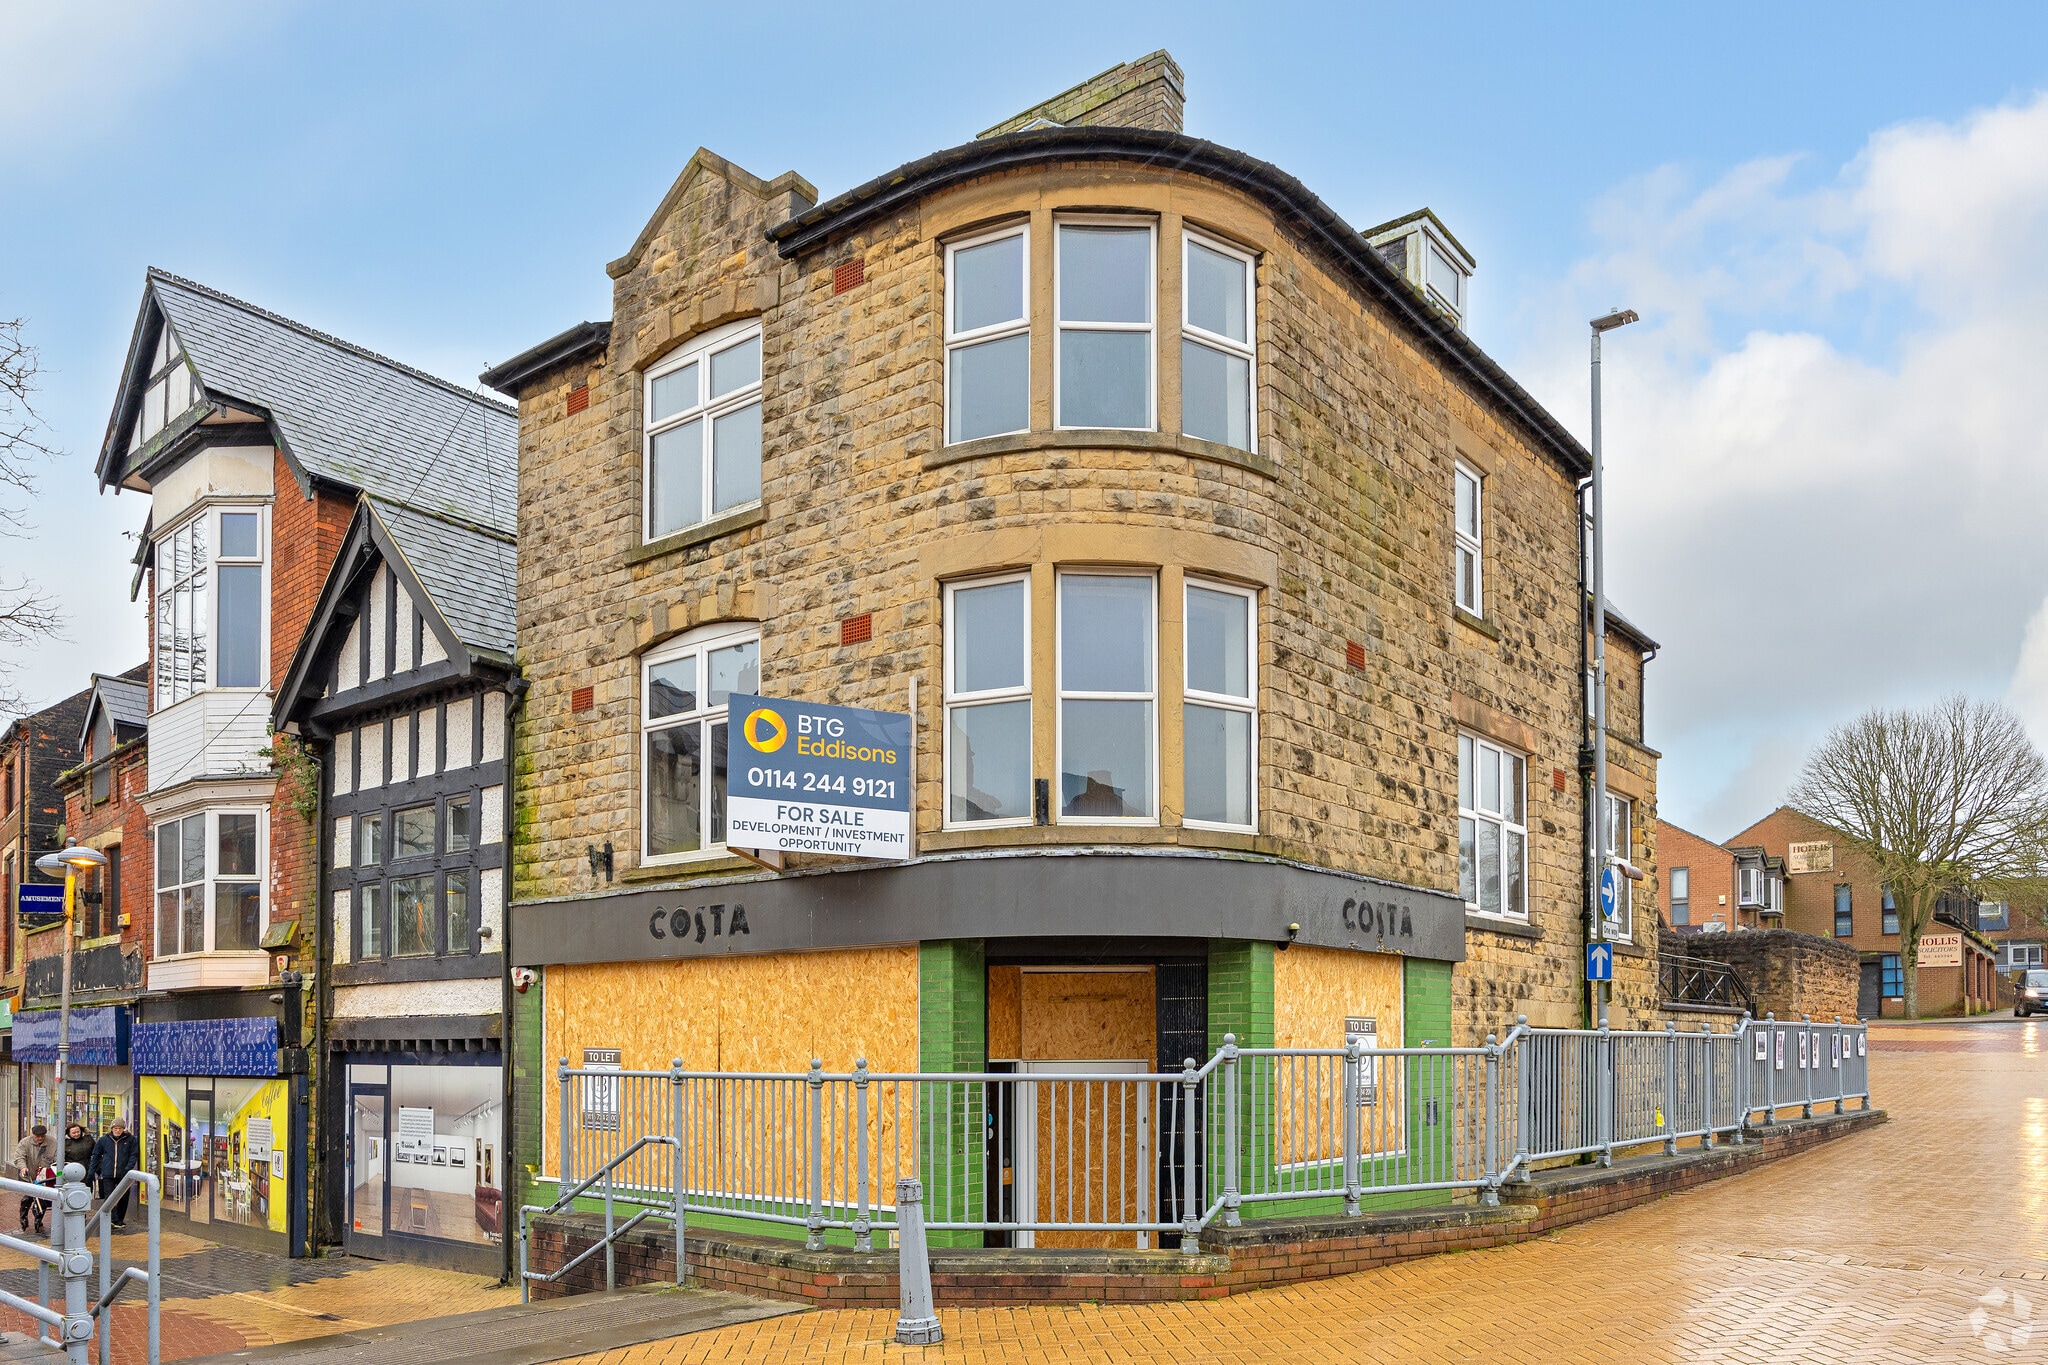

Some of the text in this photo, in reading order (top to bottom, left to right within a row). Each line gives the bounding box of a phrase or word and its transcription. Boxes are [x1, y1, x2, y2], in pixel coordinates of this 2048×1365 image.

[798, 715, 845, 737] BTG
[797, 736, 897, 764] Eddisons
[747, 767, 895, 799] 0114 244 9121
[777, 805, 864, 827] FOR SALE
[732, 820, 905, 843] DEVELOPMENT / INVESTMENT
[779, 837, 861, 853] OPPORTUNITY
[649, 903, 750, 944] COSTA
[1342, 898, 1413, 943] COSTA
[1349, 1021, 1372, 1032] TO LET
[588, 1052, 616, 1062] TO LET
